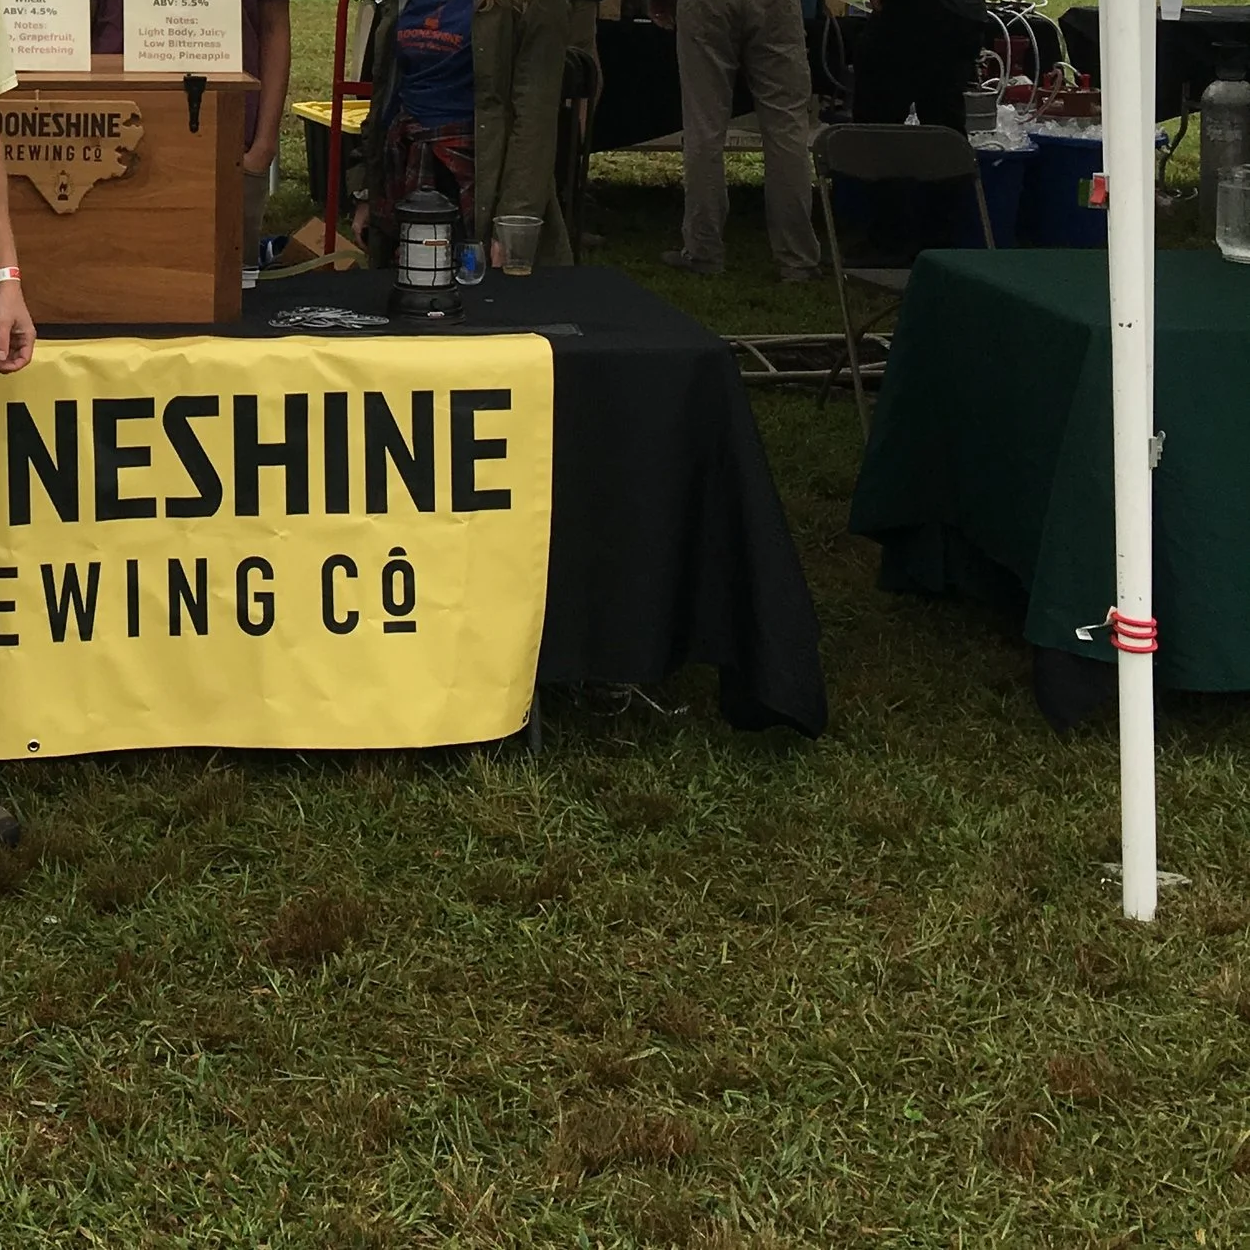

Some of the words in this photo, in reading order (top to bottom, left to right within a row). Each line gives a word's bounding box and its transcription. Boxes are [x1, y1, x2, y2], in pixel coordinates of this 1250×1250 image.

[3, 7, 27, 15] ABV:
[165, 16, 198, 25] Notes:
[14, 21, 47, 30] Notes:
[19, 33, 75, 42] Grapefruit,
[138, 28, 165, 38] Light
[168, 28, 196, 38] Body,
[200, 28, 226, 38] Juicy
[144, 40, 165, 48] Low
[168, 40, 221, 48] Bitterness
[17, 45, 74, 55] Refreshing
[138, 51, 176, 61] Mango,
[179, 51, 230, 61] Pineapple
[4, 144, 75, 161] REWING
